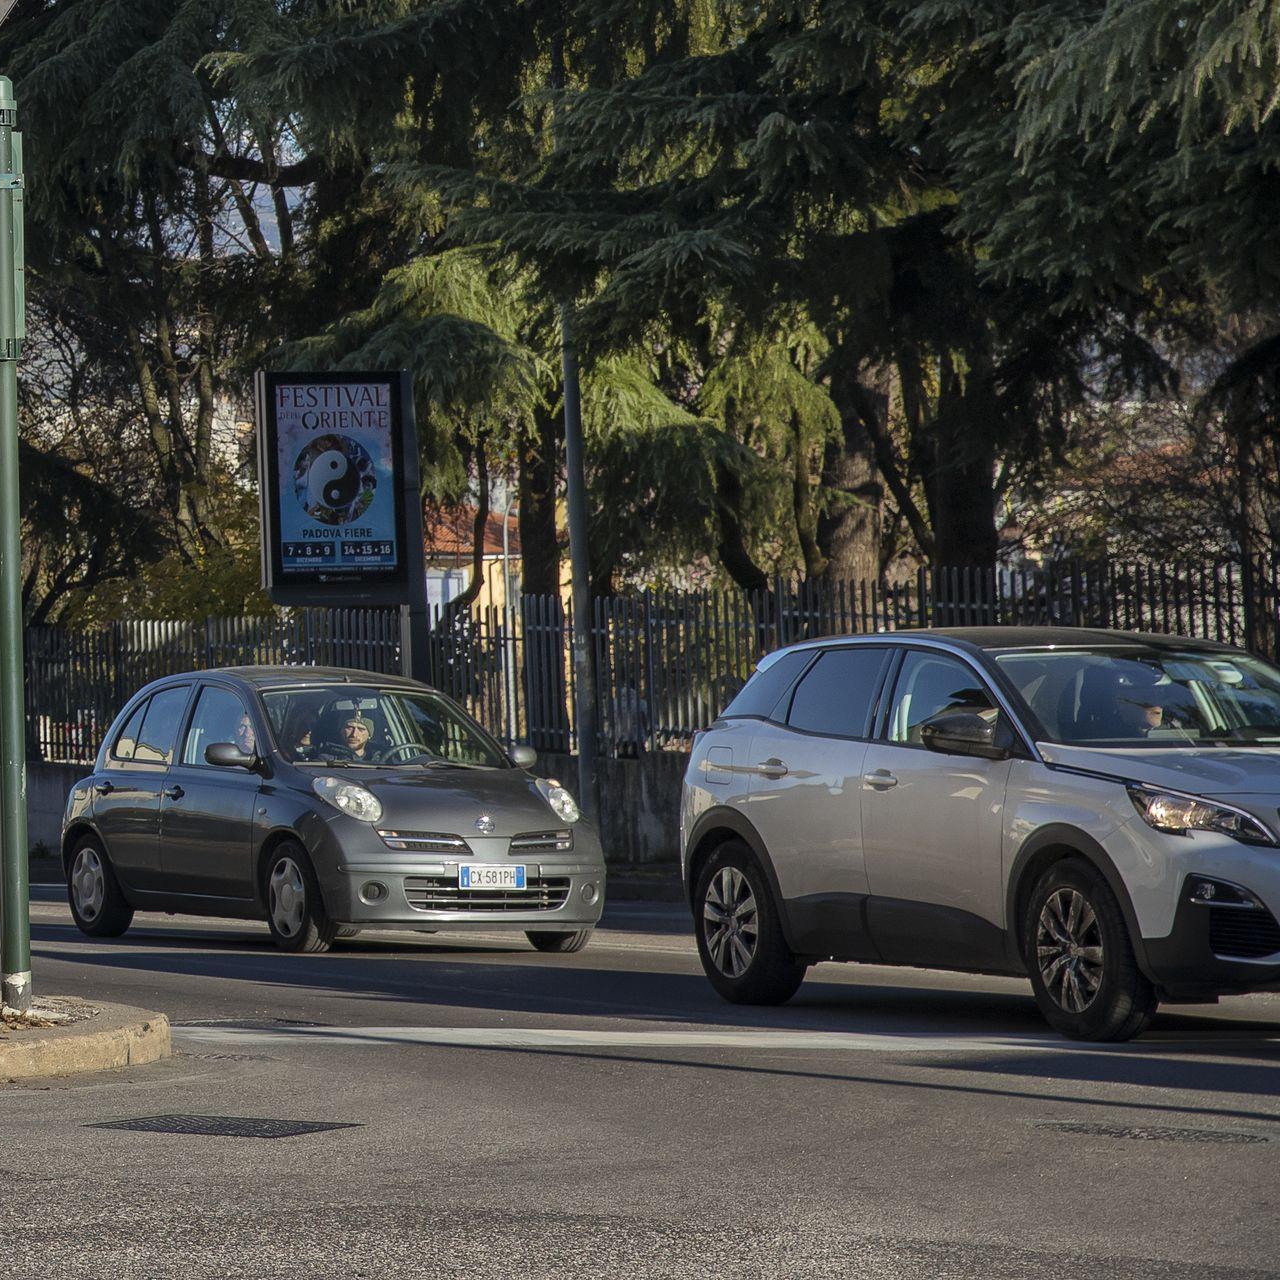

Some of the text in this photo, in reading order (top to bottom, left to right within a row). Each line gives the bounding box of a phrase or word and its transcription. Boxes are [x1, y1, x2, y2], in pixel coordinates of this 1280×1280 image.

[279, 386, 388, 408] FESTIVAL
[302, 411, 389, 430] ORIENTE
[302, 528, 373, 538] PADOVA FIERE
